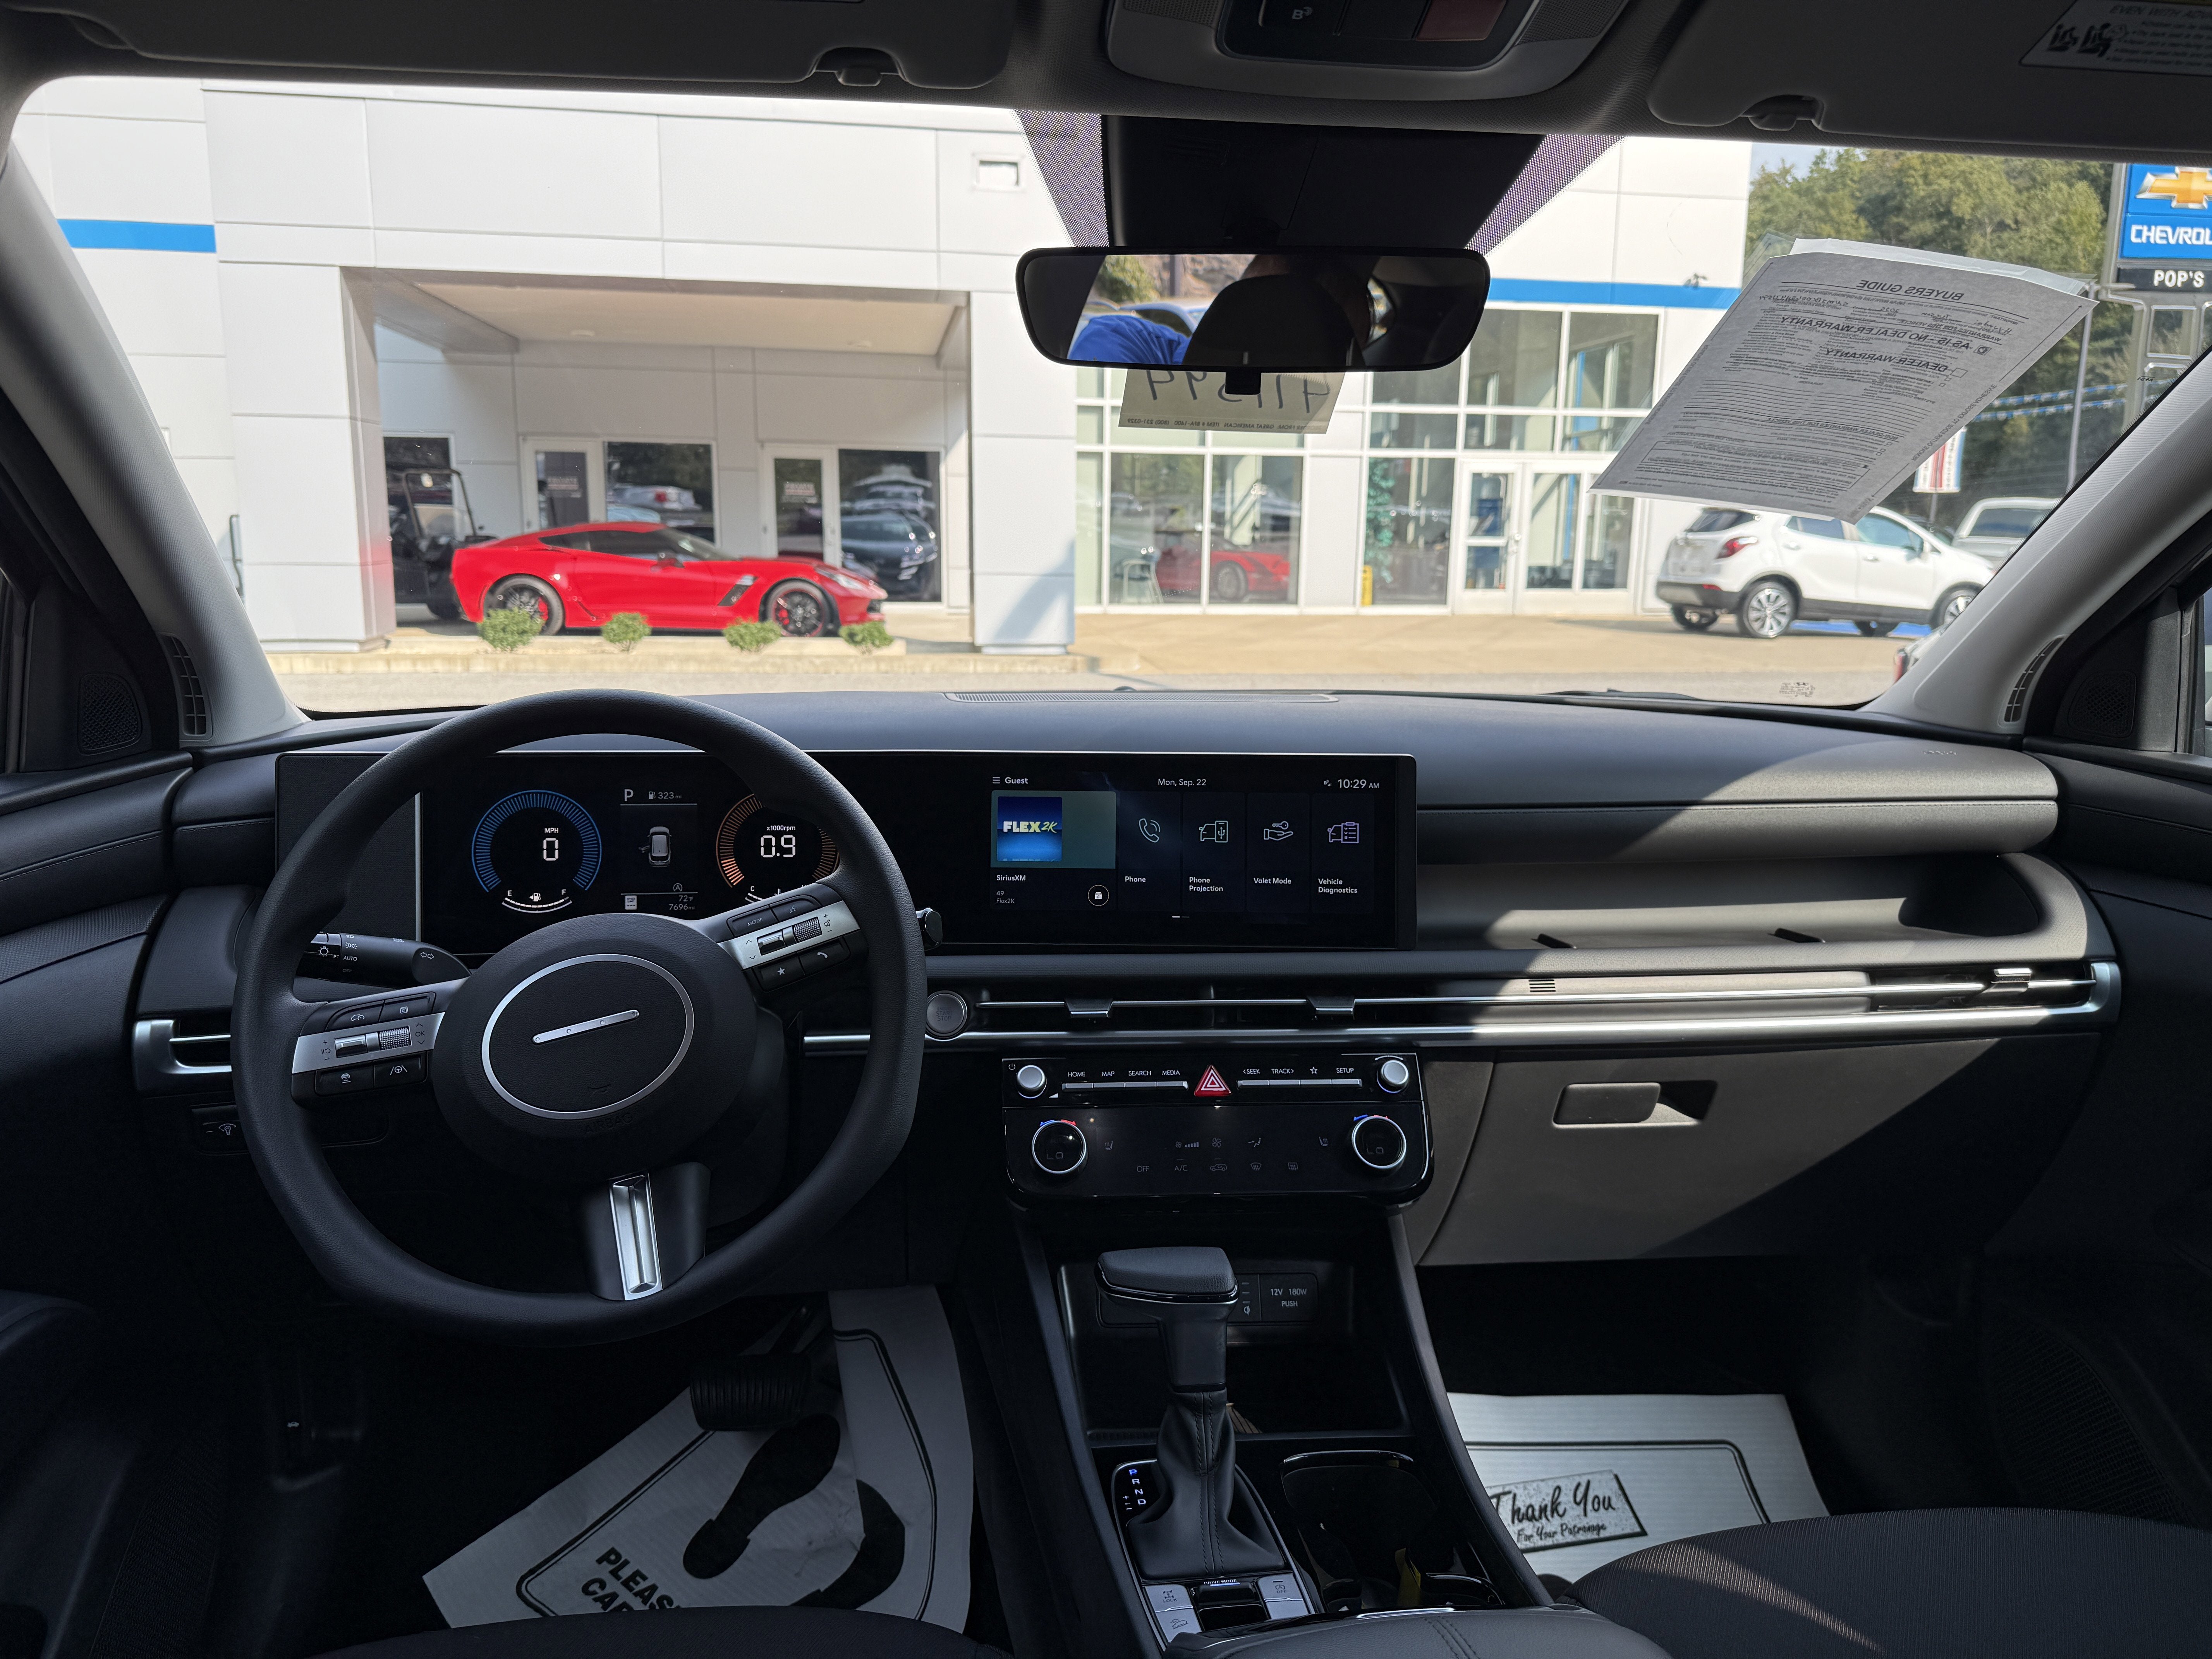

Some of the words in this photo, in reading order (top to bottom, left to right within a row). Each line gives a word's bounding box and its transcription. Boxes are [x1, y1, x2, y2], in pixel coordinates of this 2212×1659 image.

[2154, 270, 2204, 288] POP'S
[1158, 778, 1177, 787] Mon,
[1178, 778, 1196, 787] Sep.
[1338, 779, 1367, 788] 10:29
[624, 789, 634, 802] P
[1003, 821, 1042, 833] FLEX
[1041, 821, 1058, 833] 2K
[543, 838, 559, 861] 0
[761, 835, 796, 858] 0.9
[1318, 886, 1358, 895] Diagnostics
[747, 918, 763, 927] MODE
[1489, 1484, 1566, 1524] Thank
[1572, 1479, 1616, 1519] You
[595, 1546, 682, 1609] PLEAS
